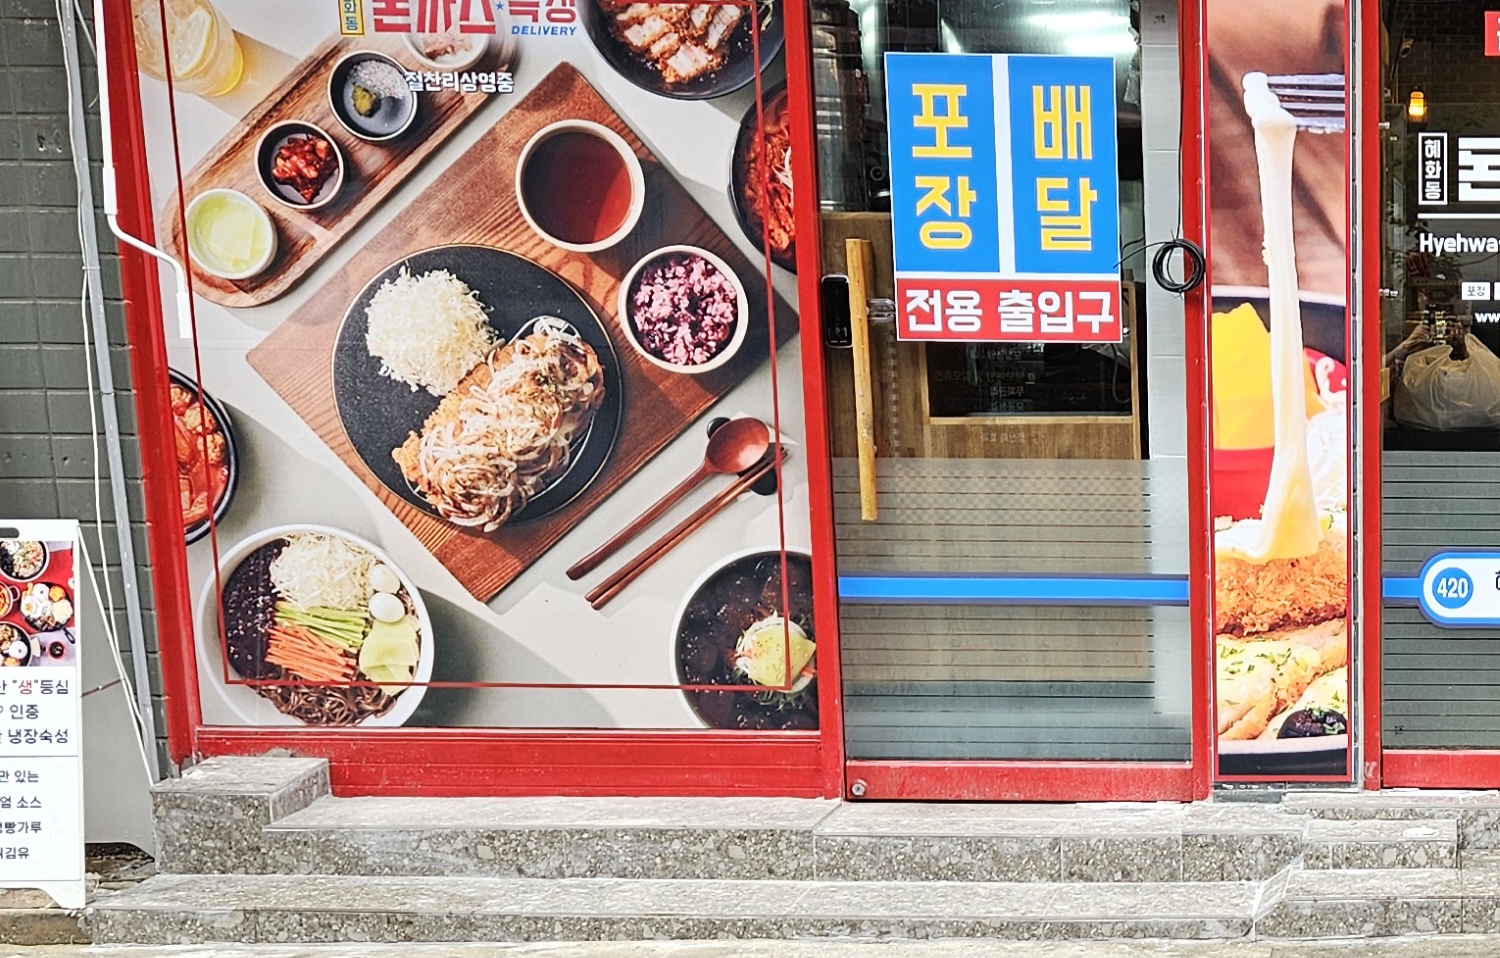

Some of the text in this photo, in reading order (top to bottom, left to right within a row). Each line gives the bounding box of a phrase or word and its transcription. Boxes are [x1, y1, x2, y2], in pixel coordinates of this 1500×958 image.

[511, 26, 577, 36] DELIVERY
[405, 71, 515, 93] 절찬리상영중
[911, 83, 977, 251] 포장
[1031, 84, 1099, 252] 배달
[1424, 139, 1441, 200] 혜화동
[904, 288, 1115, 333] 전용 출입구
[1436, 577, 1469, 598] 420
[9, 704, 39, 720] 인증
[8, 728, 69, 744] 냉장숙성
[14, 770, 39, 783] 있는
[16, 796, 42, 809] 소스
